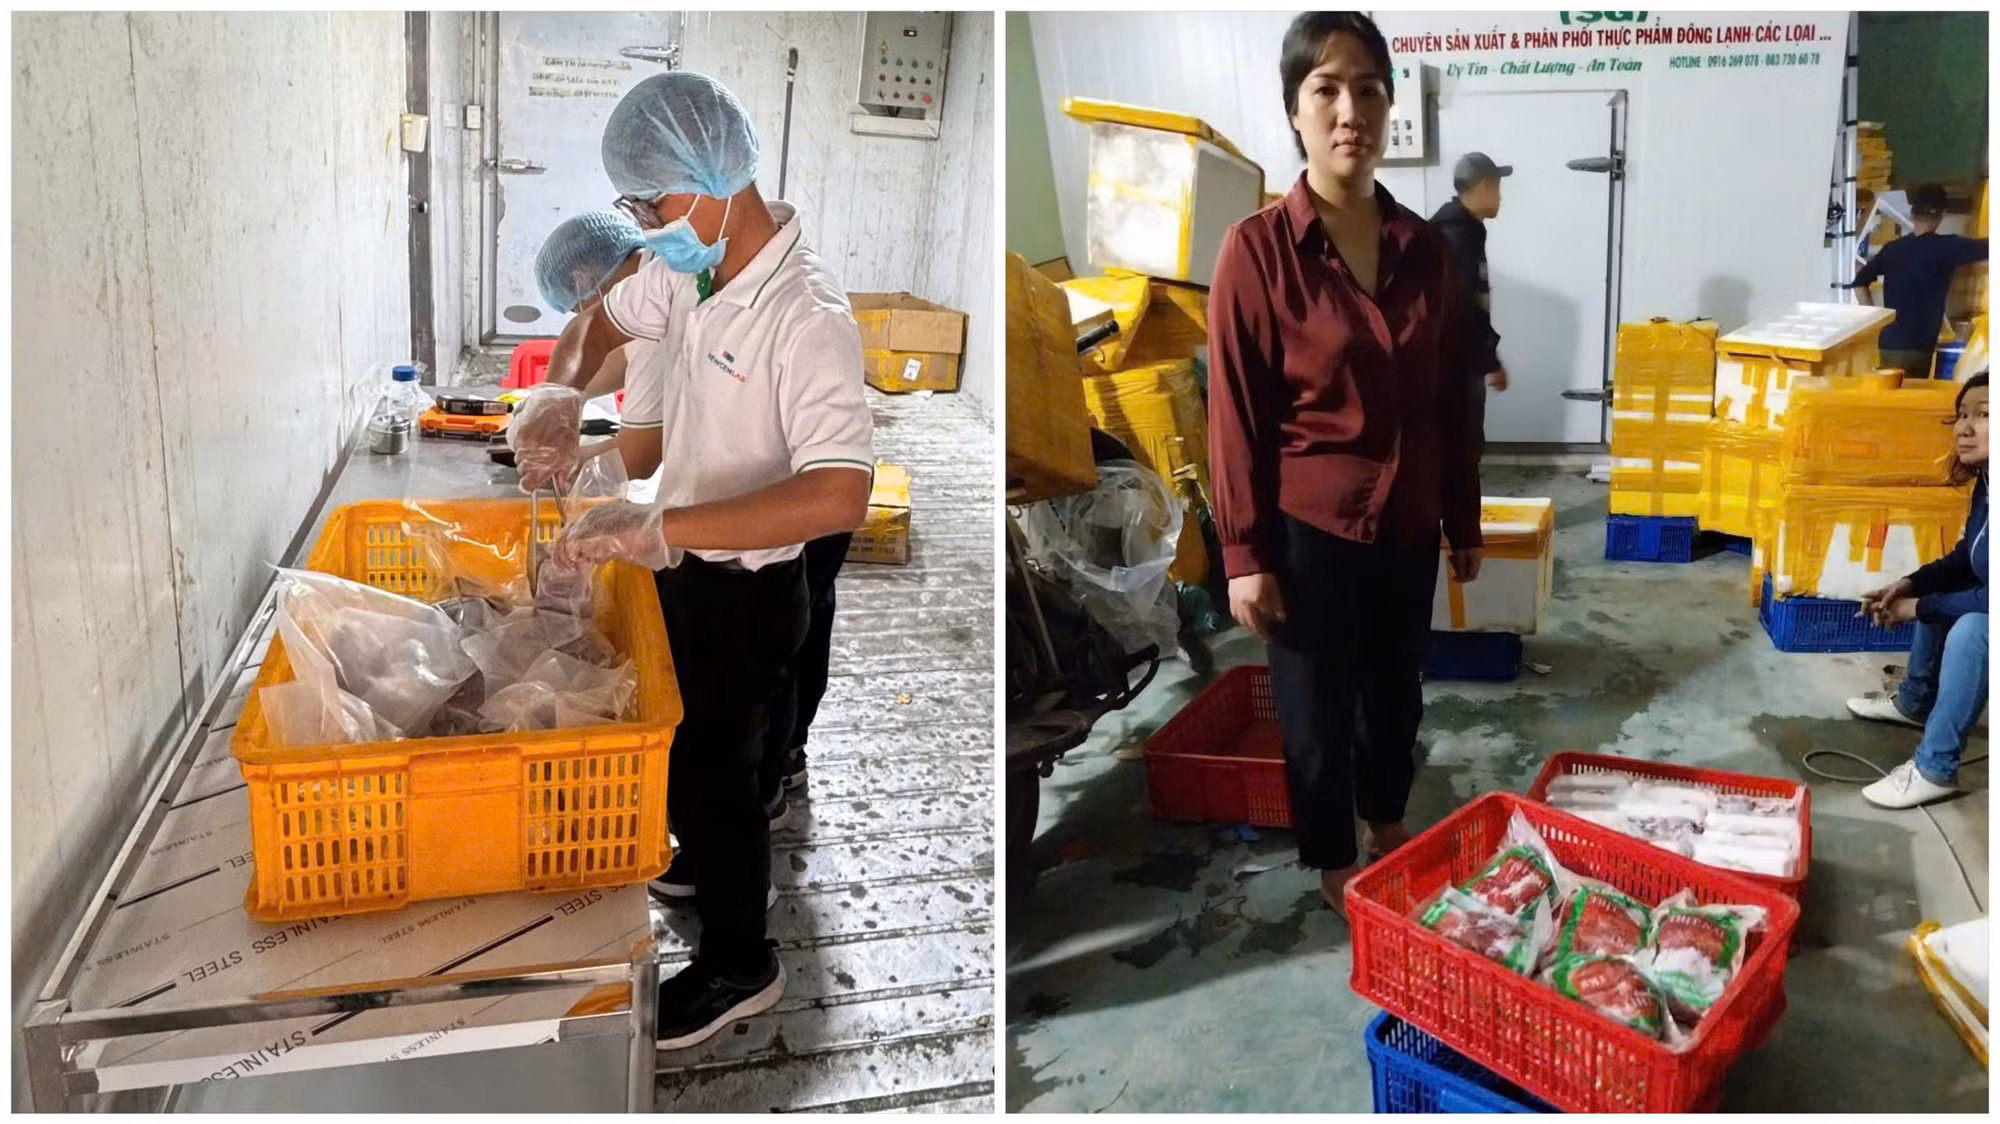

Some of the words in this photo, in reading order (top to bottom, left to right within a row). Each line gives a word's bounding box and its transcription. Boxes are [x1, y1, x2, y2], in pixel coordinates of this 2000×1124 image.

[1392, 31, 1442, 53] CHUYÊN
[1445, 28, 1470, 51] SẢN
[1474, 24, 1506, 50] XUẤT
[1510, 33, 1520, 50] &
[1524, 27, 1558, 49] PHÂN
[1562, 23, 1593, 48] PHỐI
[1596, 25, 1632, 50] THỰC
[1636, 17, 1673, 45] PHẨM
[1677, 23, 1713, 44] ĐÔNG
[1716, 26, 1751, 48] LẠNH
[1755, 20, 1782, 42] CÁC
[225, 851, 254, 868] EEL
[555, 889, 602, 916] STEEL
[252, 915, 341, 954] AINLESS
[382, 925, 415, 943] STEEL
[182, 950, 243, 983] STEEL
[401, 1018, 465, 1055] STAINLESS
